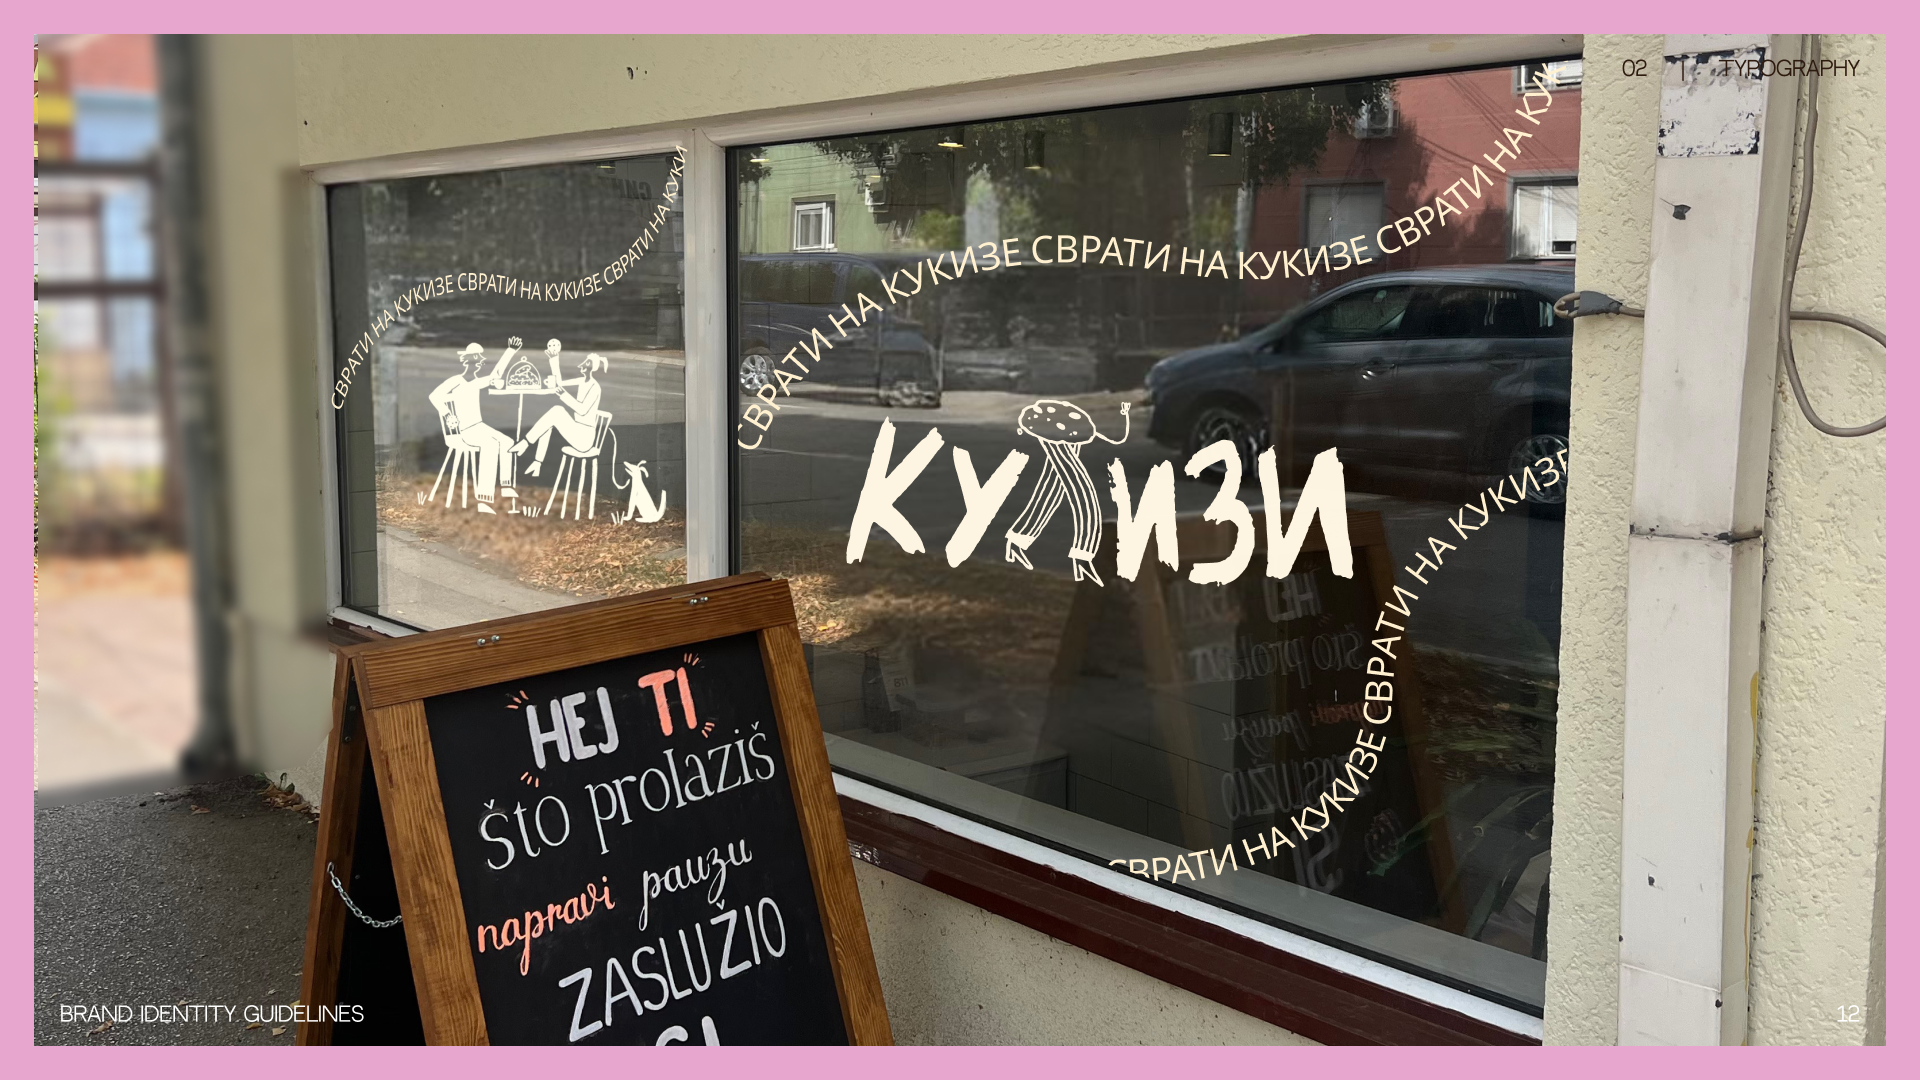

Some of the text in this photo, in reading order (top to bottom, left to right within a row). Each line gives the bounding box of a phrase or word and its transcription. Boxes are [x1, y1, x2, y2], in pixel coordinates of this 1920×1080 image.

[331, 144, 688, 410] СВРАТИ НА КУКИЗЕ СВРАТИ НА КУКИЗЕ СВРАТИ НА КУКИ
[737, 327, 834, 450] СВРАТИ
[828, 292, 884, 338] НА
[881, 237, 1022, 305] КУКИЗЕ
[1032, 235, 1171, 272] СВРАТИ
[1180, 246, 1229, 279] НА
[1239, 234, 1373, 280] КУКИЗЕ
[1376, 164, 1494, 254] СВРАТИ
[1483, 127, 1533, 174] НА
[526, 667, 697, 769] HEJ TI
[1242, 826, 1296, 866] НА
[1290, 729, 1387, 842] КУКИЗЕ
[1363, 585, 1419, 725] СВРАТИ
[1404, 536, 1457, 585] НА
[585, 721, 776, 855] prolaziš
[477, 839, 753, 976] napravi pauzu
[558, 898, 787, 1042] ZASLUŽIO
